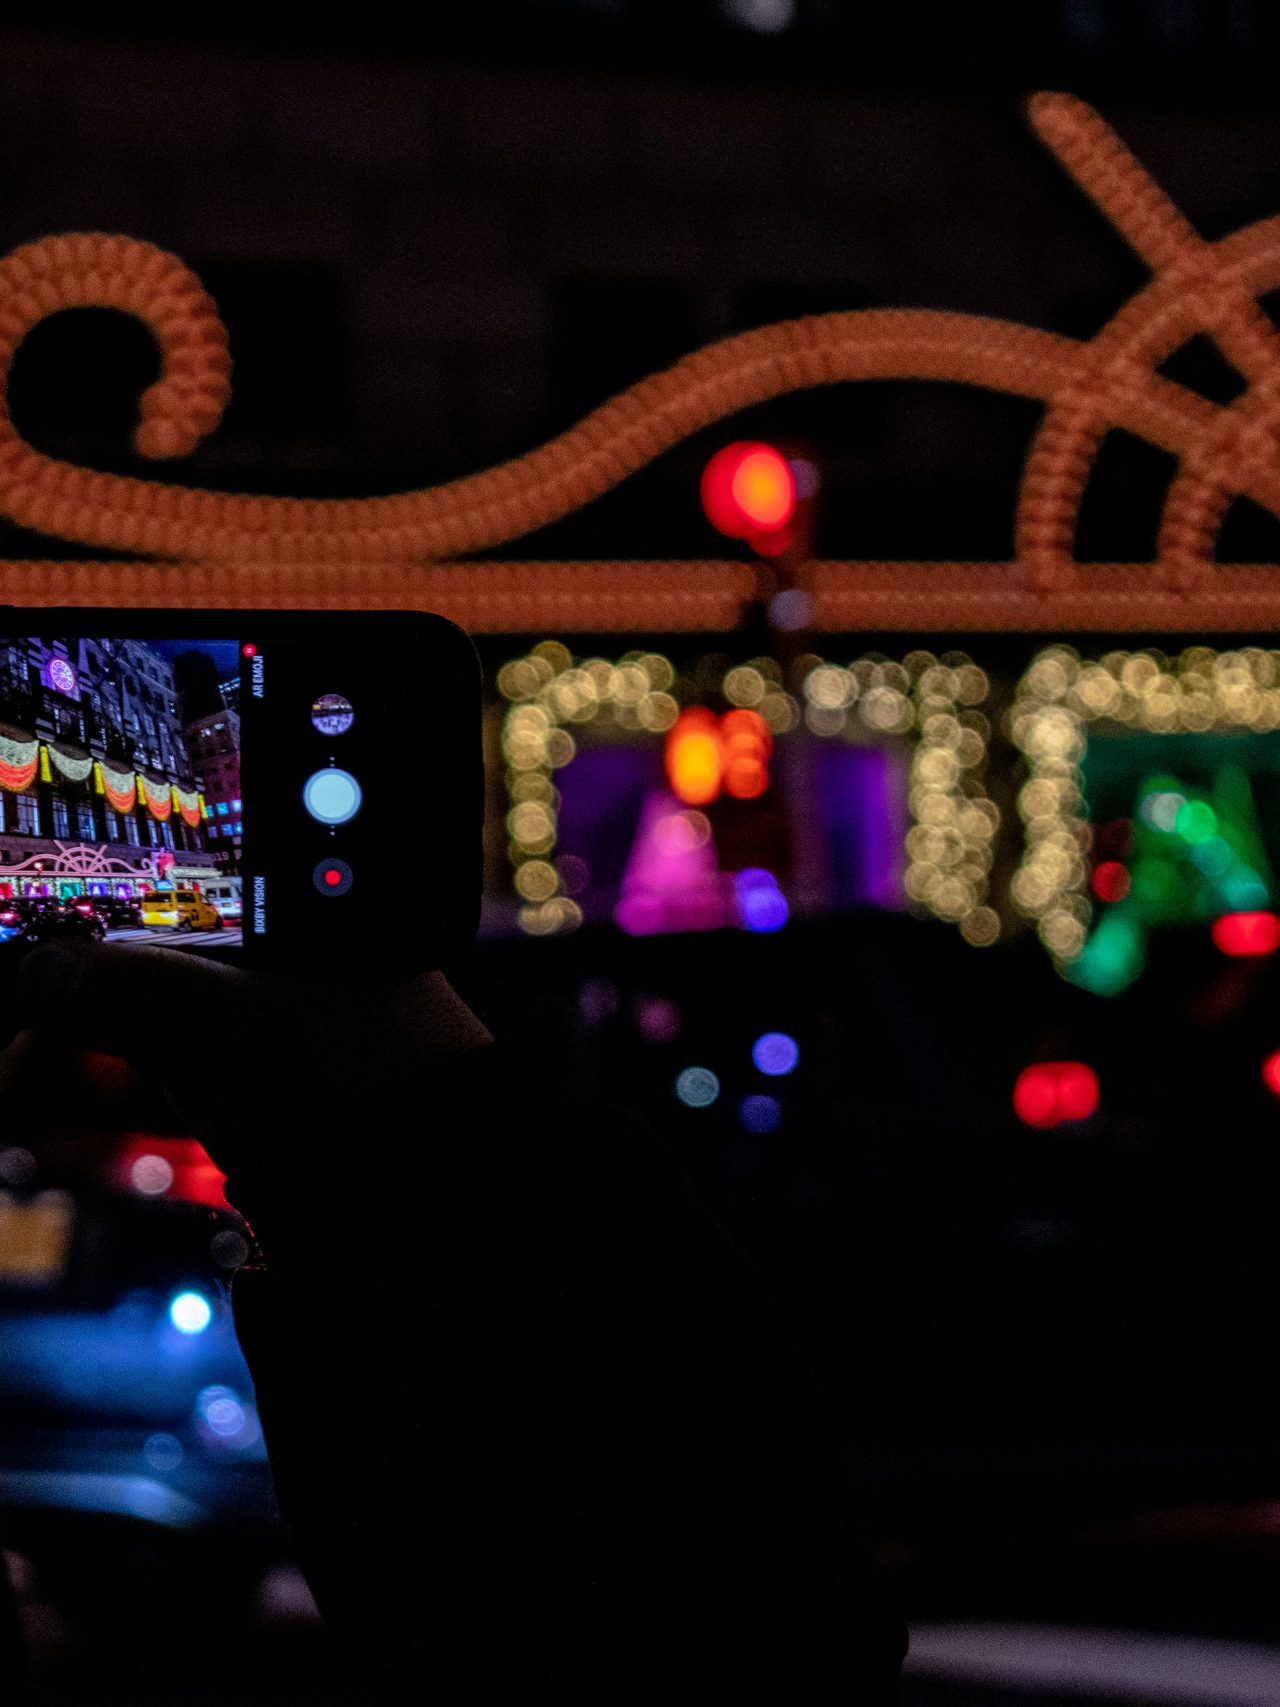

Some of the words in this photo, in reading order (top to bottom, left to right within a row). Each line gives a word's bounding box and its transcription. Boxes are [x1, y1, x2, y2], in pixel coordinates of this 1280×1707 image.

[252, 655, 264, 683] EMOJI
[252, 684, 264, 698] AR
[254, 876, 265, 906] VISION
[254, 907, 265, 934] BIXBY
